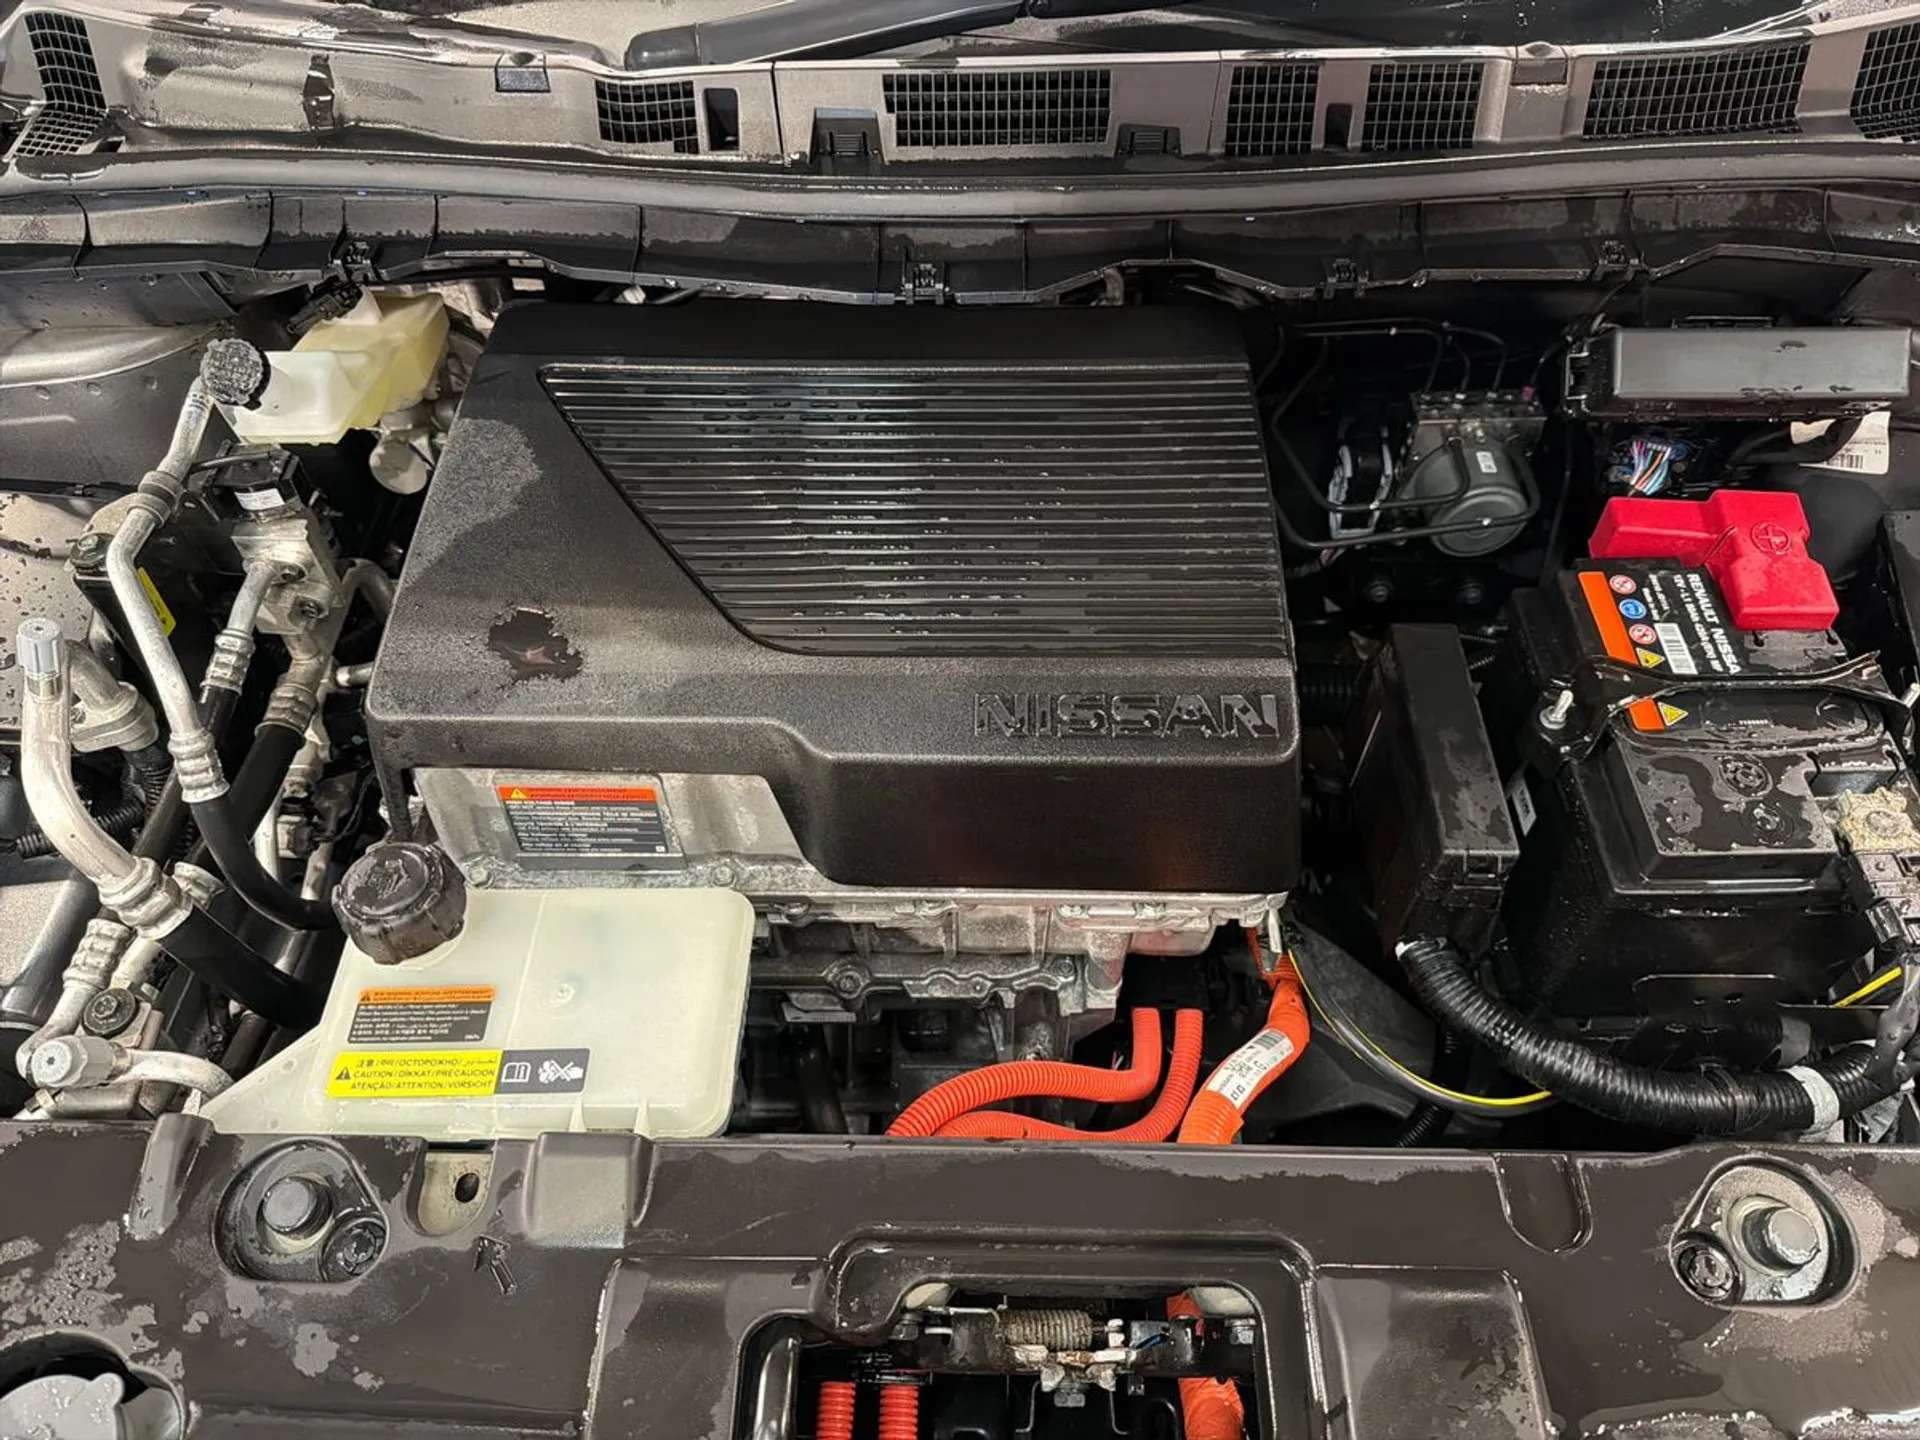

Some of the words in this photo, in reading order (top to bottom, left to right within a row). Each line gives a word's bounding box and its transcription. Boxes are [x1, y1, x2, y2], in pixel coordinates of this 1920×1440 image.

[1686, 574, 1720, 624] RENAULT
[1710, 627, 1741, 675] NISSA
[974, 693, 1279, 737] NISSAN
